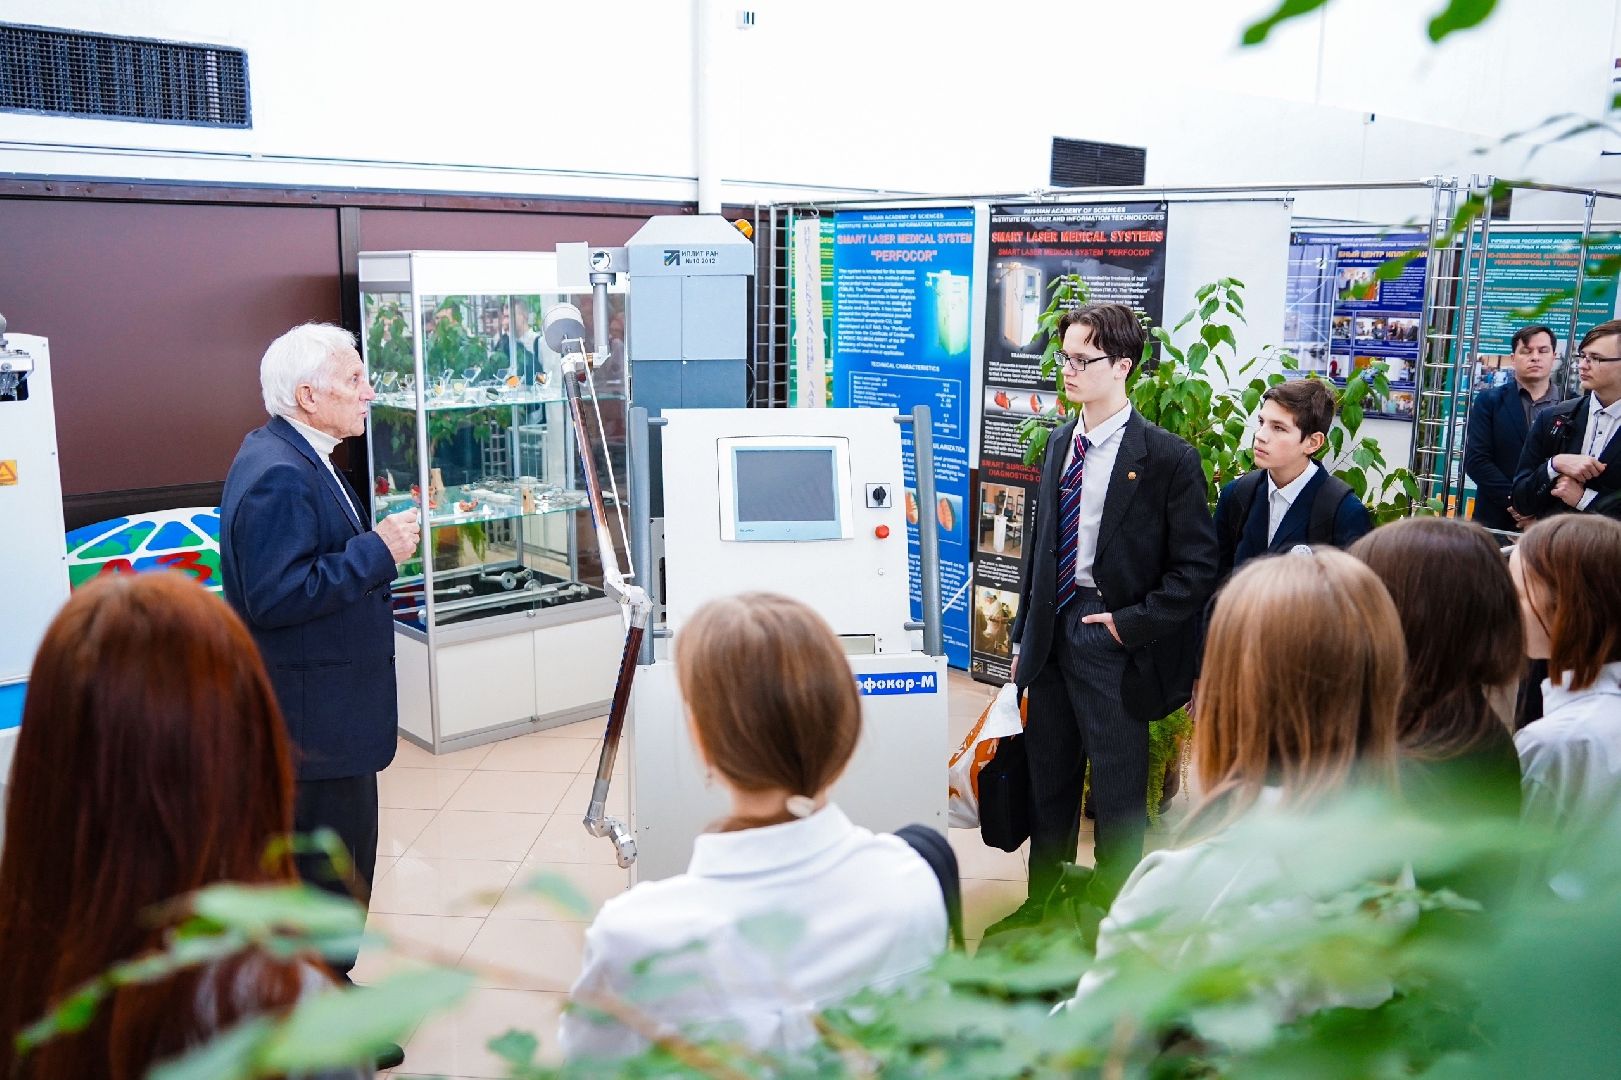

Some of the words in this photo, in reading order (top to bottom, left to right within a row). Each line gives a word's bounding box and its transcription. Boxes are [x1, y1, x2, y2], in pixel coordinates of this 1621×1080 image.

[837, 234, 866, 244] SMART
[868, 234, 895, 244] LASER
[897, 234, 936, 244] MEDICAL
[937, 233, 972, 243] SYSTEM
[991, 232, 1023, 243] SMART
[1026, 232, 1058, 243] LASER
[1060, 231, 1106, 242] MEDICAL
[1110, 231, 1163, 242] SYSTEMS
[871, 250, 938, 262] "PERFOCOR"
[856, 675, 935, 693] фокор-М
